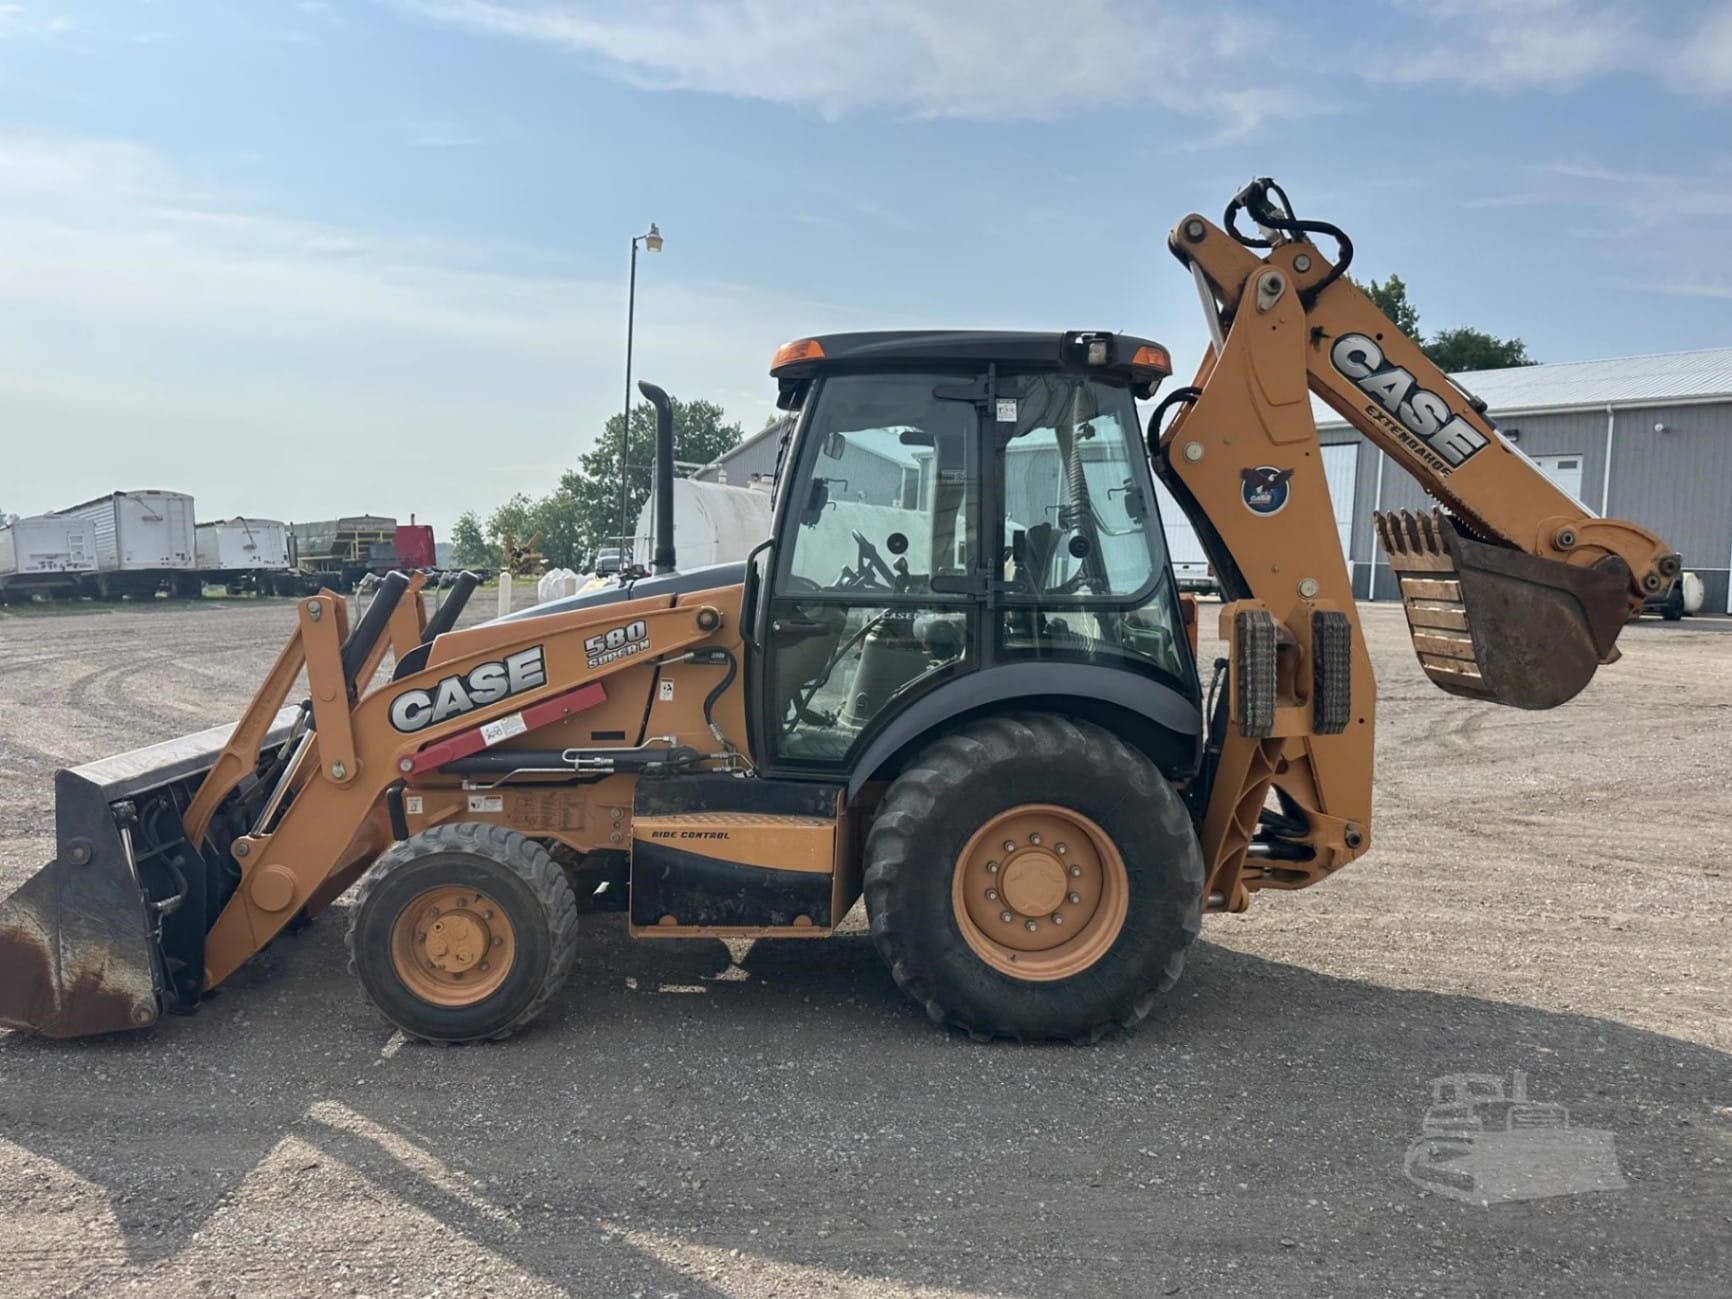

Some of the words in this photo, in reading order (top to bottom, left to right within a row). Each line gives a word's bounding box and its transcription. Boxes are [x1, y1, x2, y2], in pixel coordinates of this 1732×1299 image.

[1331, 334, 1490, 466] CASE
[1365, 405, 1453, 478] EXTENDAHOE
[585, 620, 646, 657] 580
[587, 644, 638, 669] SUPER
[389, 645, 546, 732] CASE
[651, 831, 677, 839] RIDE
[680, 831, 731, 840] CONTROL
